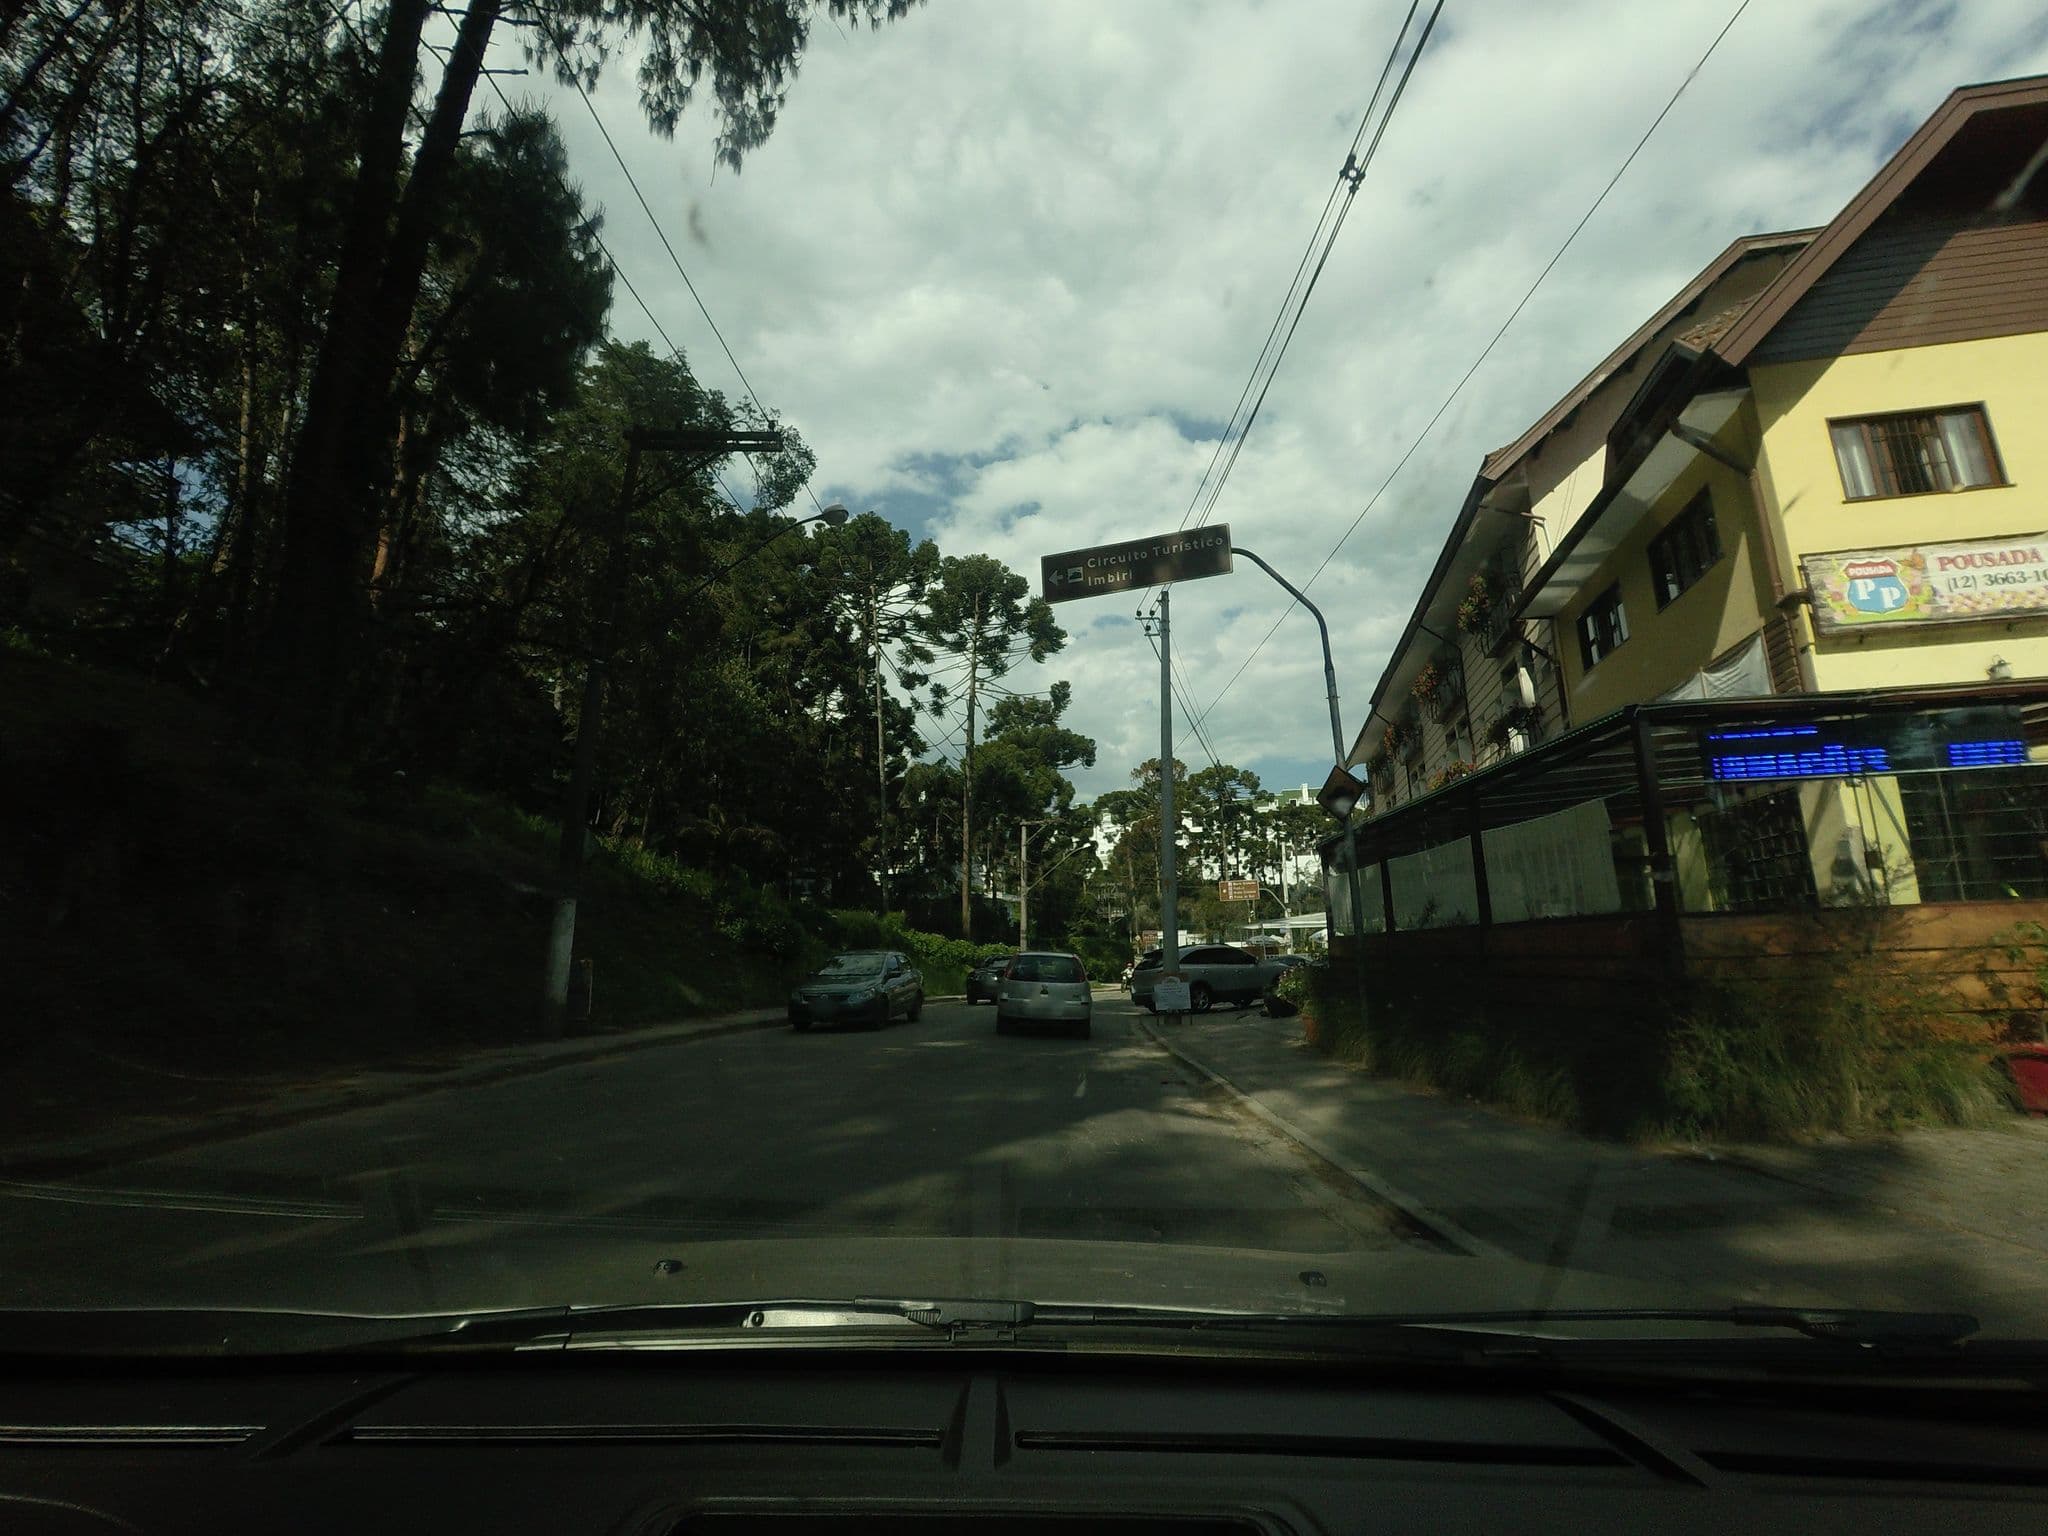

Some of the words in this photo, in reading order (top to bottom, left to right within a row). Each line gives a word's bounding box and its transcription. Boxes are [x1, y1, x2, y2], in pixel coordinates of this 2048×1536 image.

[1087, 551, 1147, 569] Circuito
[1152, 537, 1224, 556] Turístico
[1937, 548, 2045, 571] POUSADA
[1088, 571, 1133, 587] Imbiri
[1847, 564, 1894, 576] POUSADA
[1947, 574, 1977, 592] (12)
